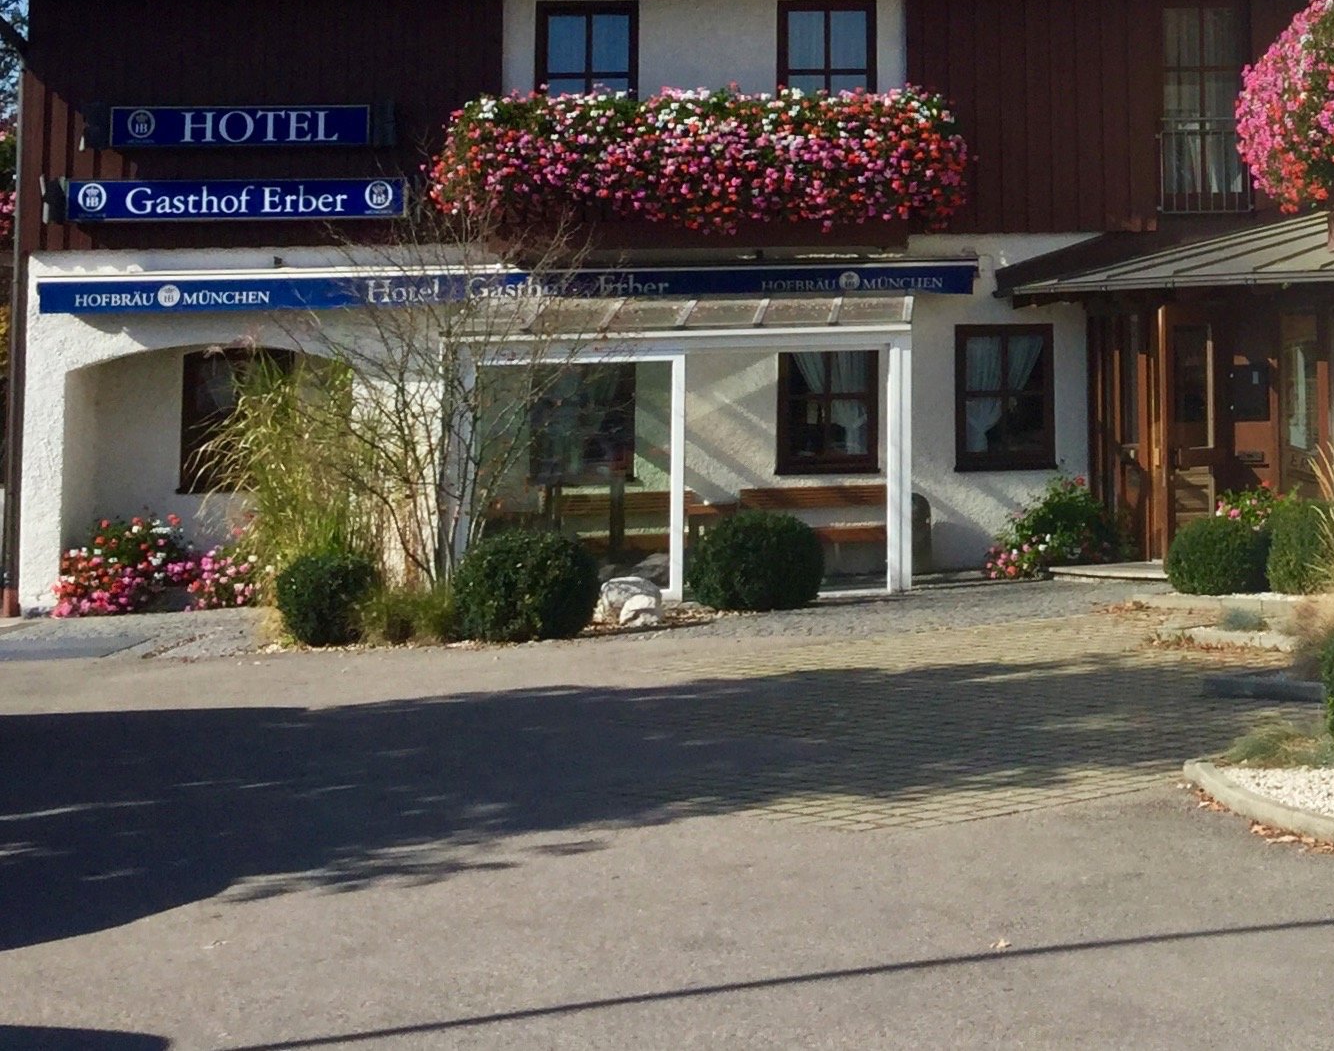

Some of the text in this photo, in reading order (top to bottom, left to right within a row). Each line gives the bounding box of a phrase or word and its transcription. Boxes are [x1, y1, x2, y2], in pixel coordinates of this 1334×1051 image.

[179, 109, 339, 143] HOTEL
[125, 185, 348, 215] Gasthof Erber
[74, 291, 155, 308] HOFBRÄU
[182, 290, 271, 306] MÜNCHEN
[364, 277, 441, 304] Hotel
[599, 273, 670, 297] Erber
[761, 276, 944, 292] HOFBRÄU MÜNCHEN
